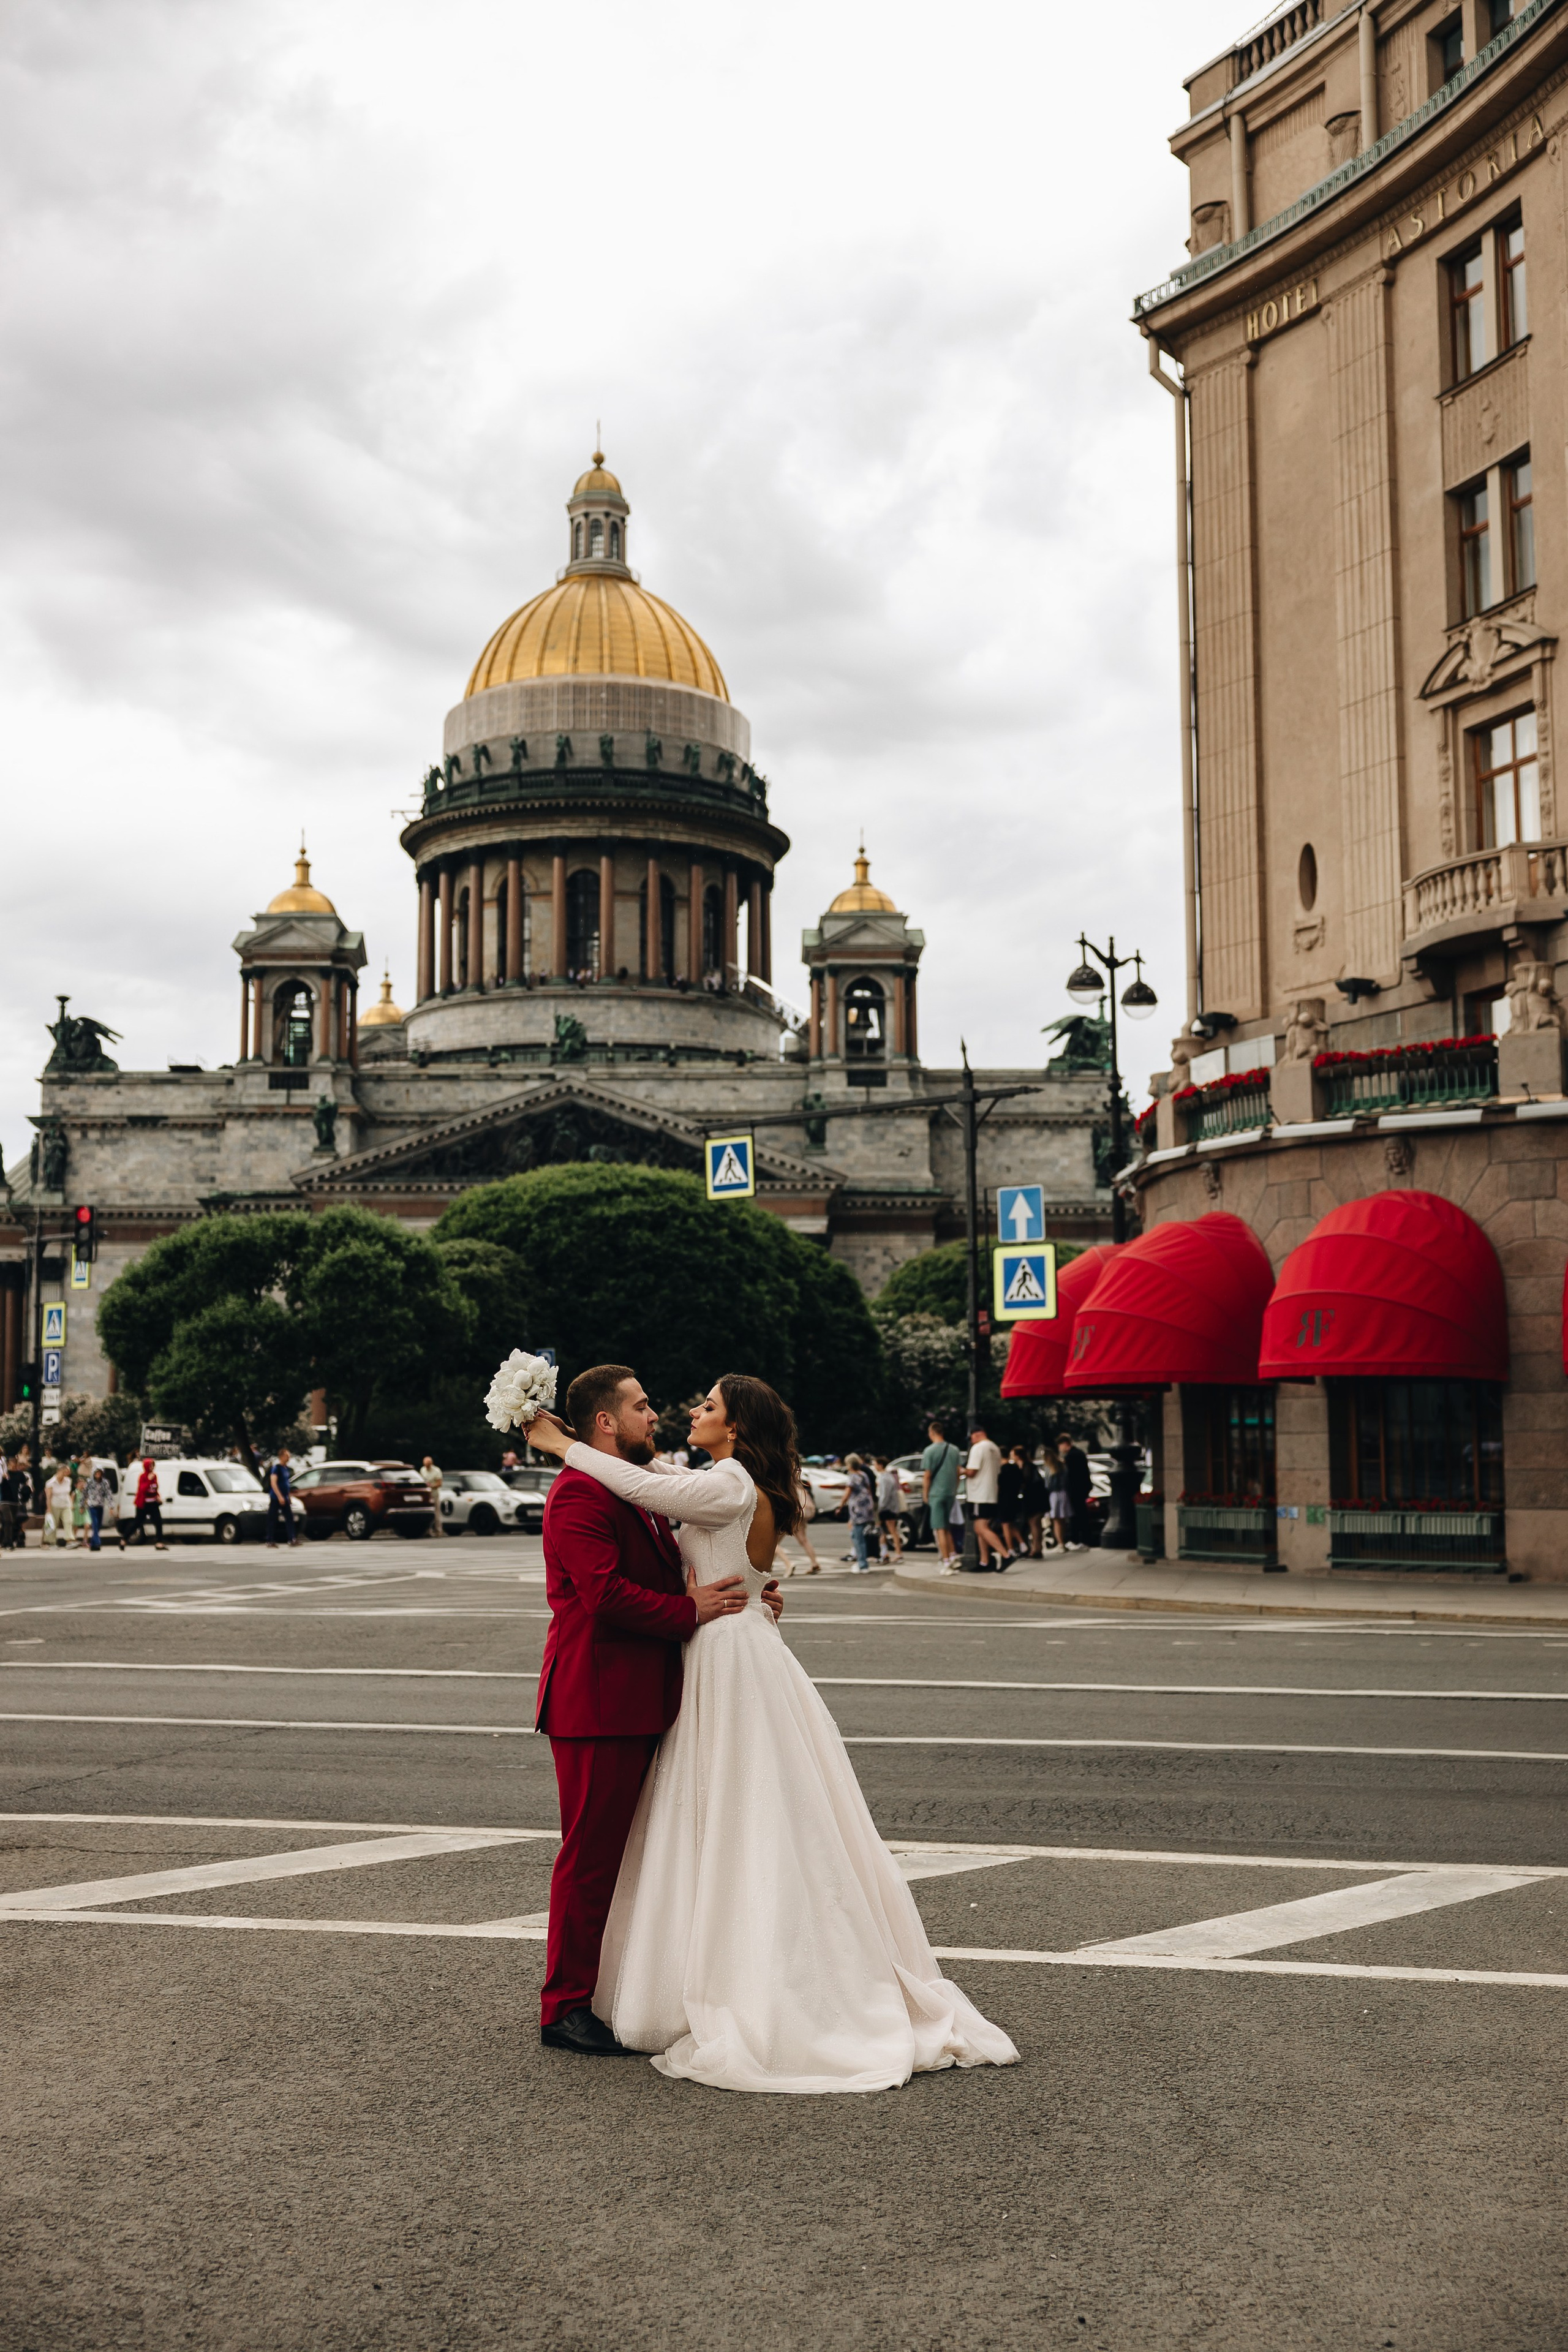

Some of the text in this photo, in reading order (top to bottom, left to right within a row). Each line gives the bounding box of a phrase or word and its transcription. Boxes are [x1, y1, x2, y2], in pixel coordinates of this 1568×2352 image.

[1247, 111, 1545, 341] HOTEL ASTORIA
[48, 1354, 58, 1381] P
